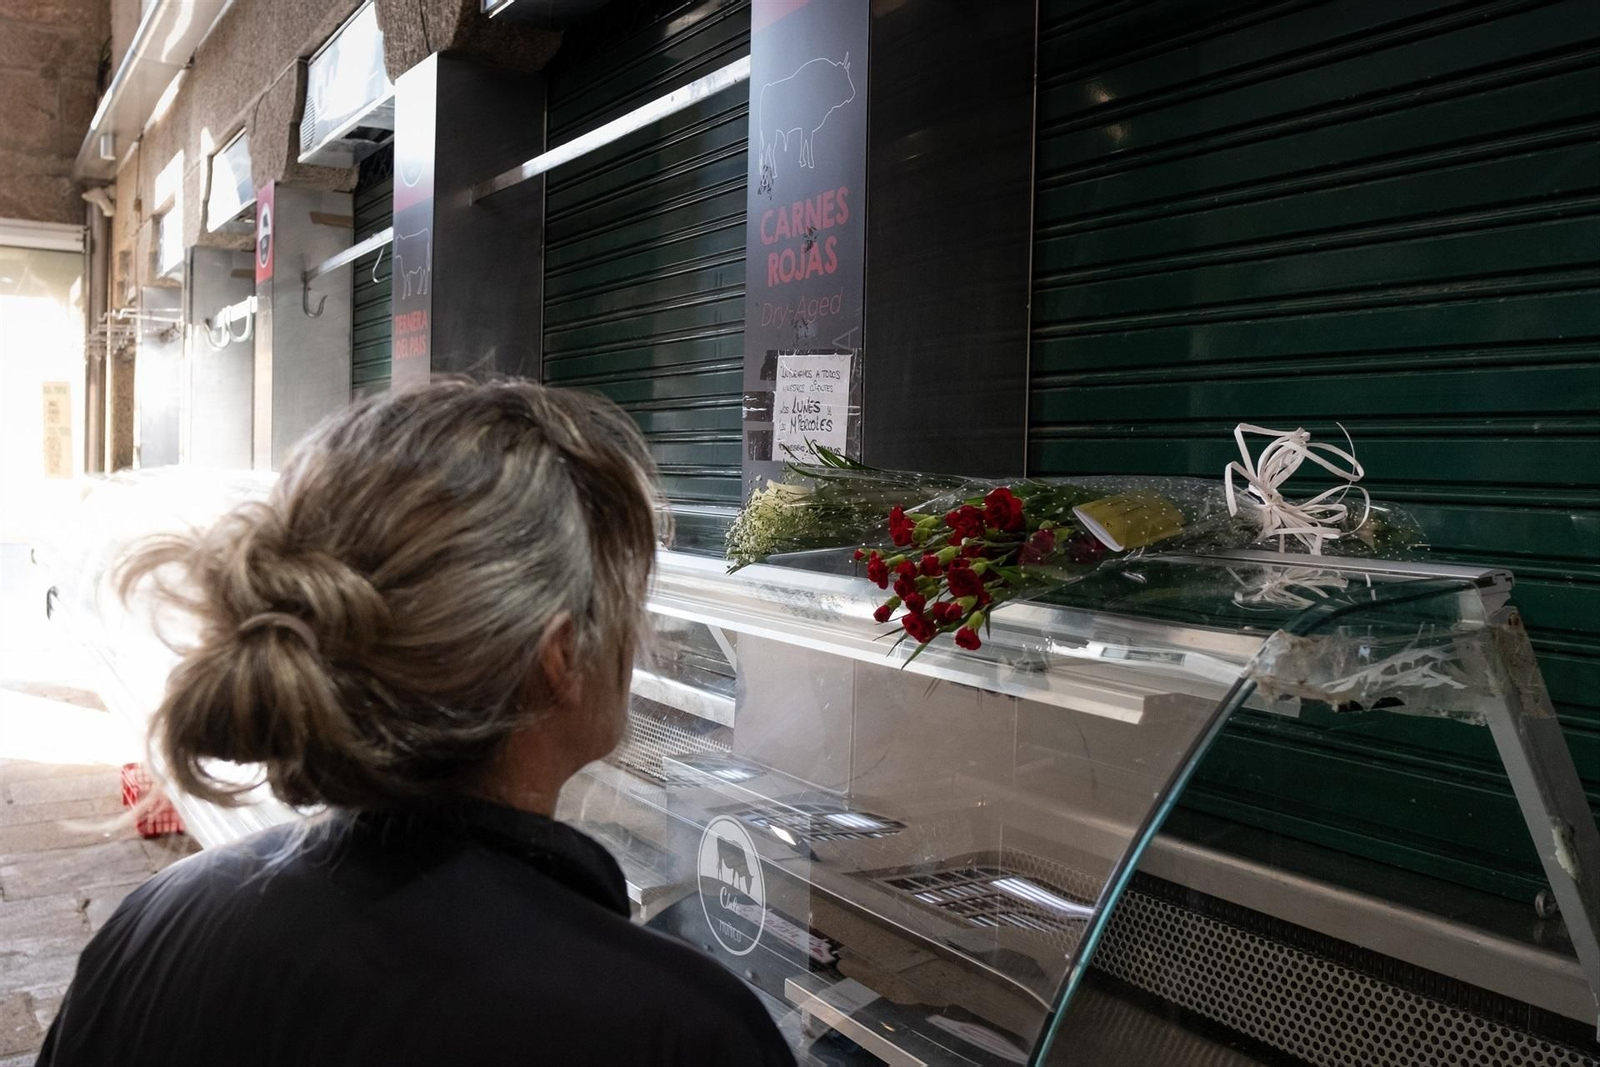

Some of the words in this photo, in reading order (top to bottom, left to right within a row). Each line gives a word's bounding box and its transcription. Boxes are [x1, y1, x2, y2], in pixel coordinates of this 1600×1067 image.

[760, 186, 849, 245] CARNES
[768, 235, 837, 287] ROJAS
[761, 287, 843, 328] Dry-Aged
[792, 395, 821, 414] LUNES
